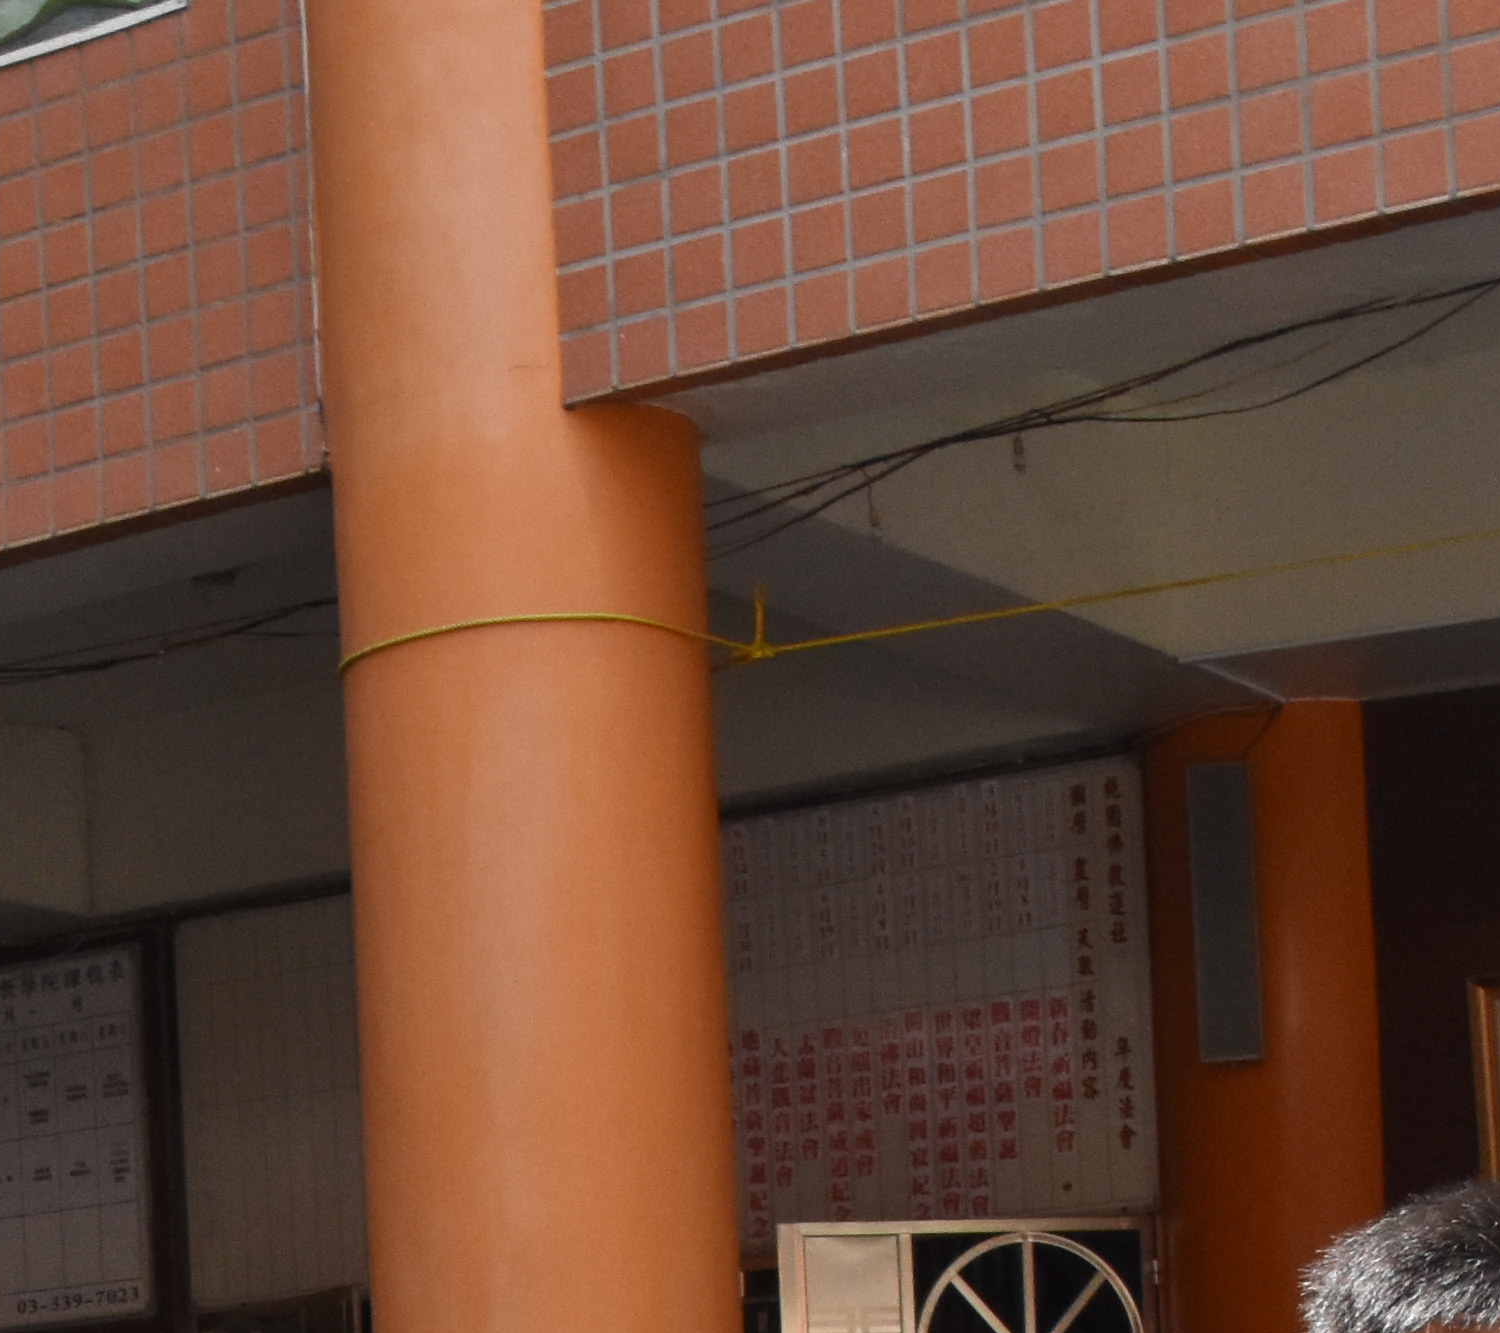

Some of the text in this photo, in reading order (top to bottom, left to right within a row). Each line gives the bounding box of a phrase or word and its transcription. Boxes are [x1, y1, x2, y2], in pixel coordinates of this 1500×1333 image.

[1049, 997, 1076, 1154] 新春祈福法會
[16, 1285, 140, 1314] 03-339-7023
